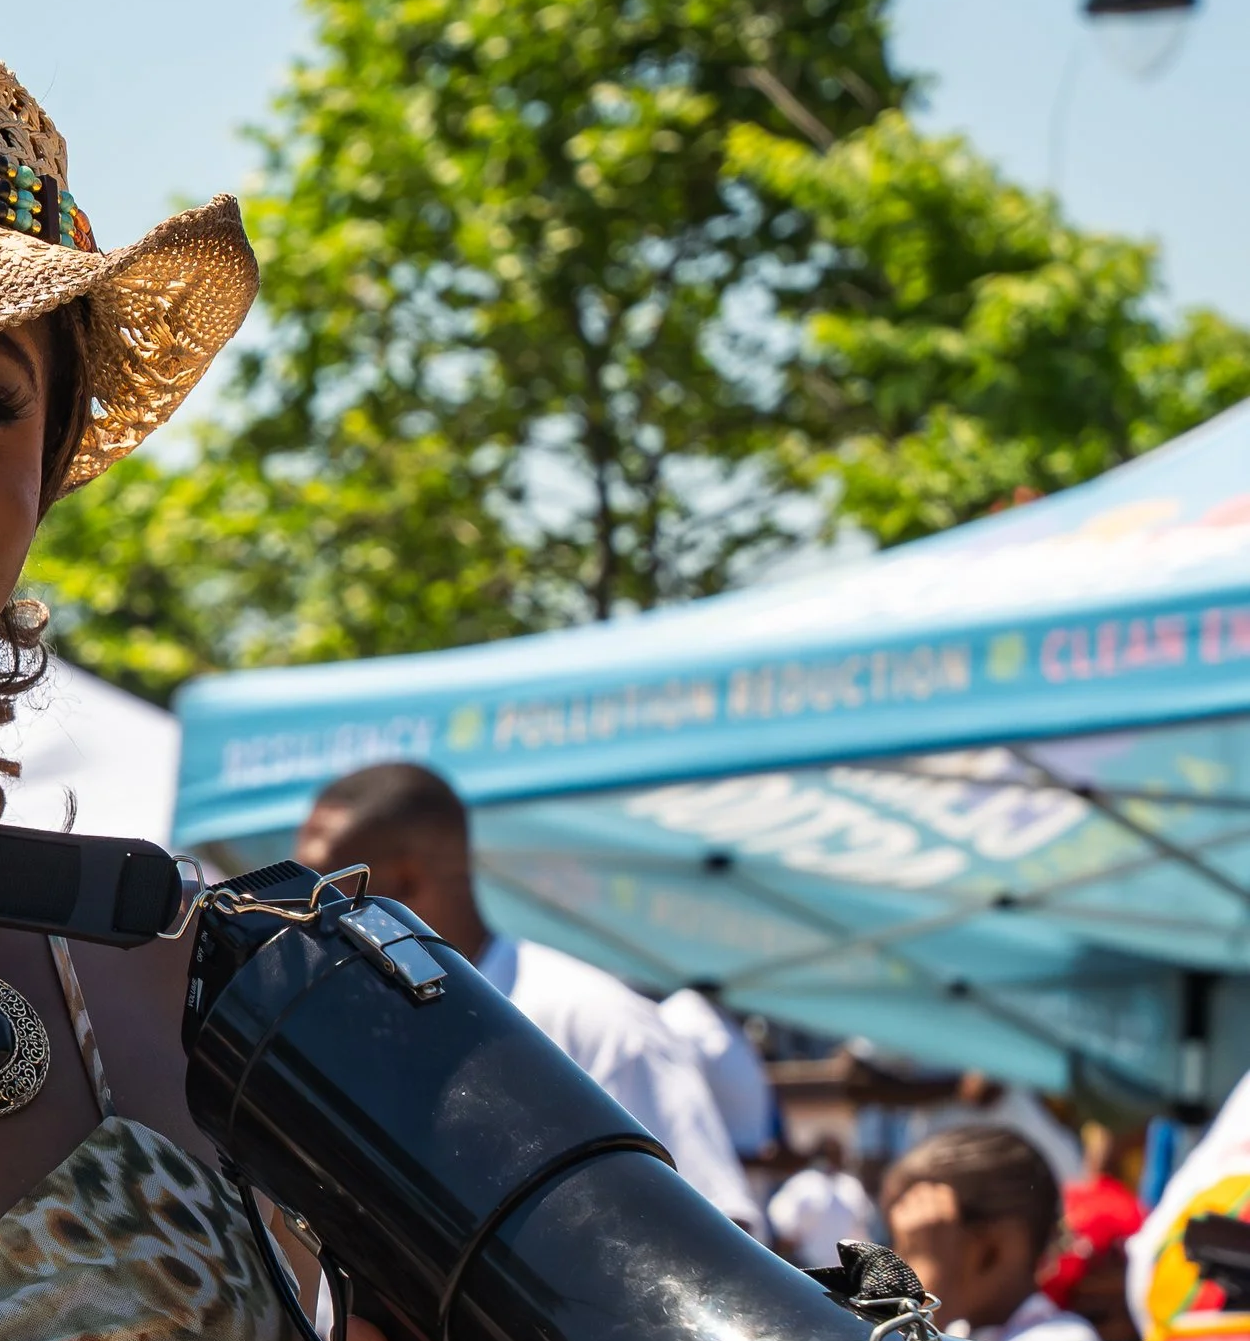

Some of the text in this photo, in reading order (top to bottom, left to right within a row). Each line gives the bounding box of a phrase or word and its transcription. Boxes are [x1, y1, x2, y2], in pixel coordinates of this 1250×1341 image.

[494, 680, 715, 749] POLLUTION
[728, 644, 970, 719] REDUCTION
[1041, 615, 1185, 683] CLEAN
[196, 930, 209, 963] OFF ON
[187, 977, 198, 1008] VOLUME
